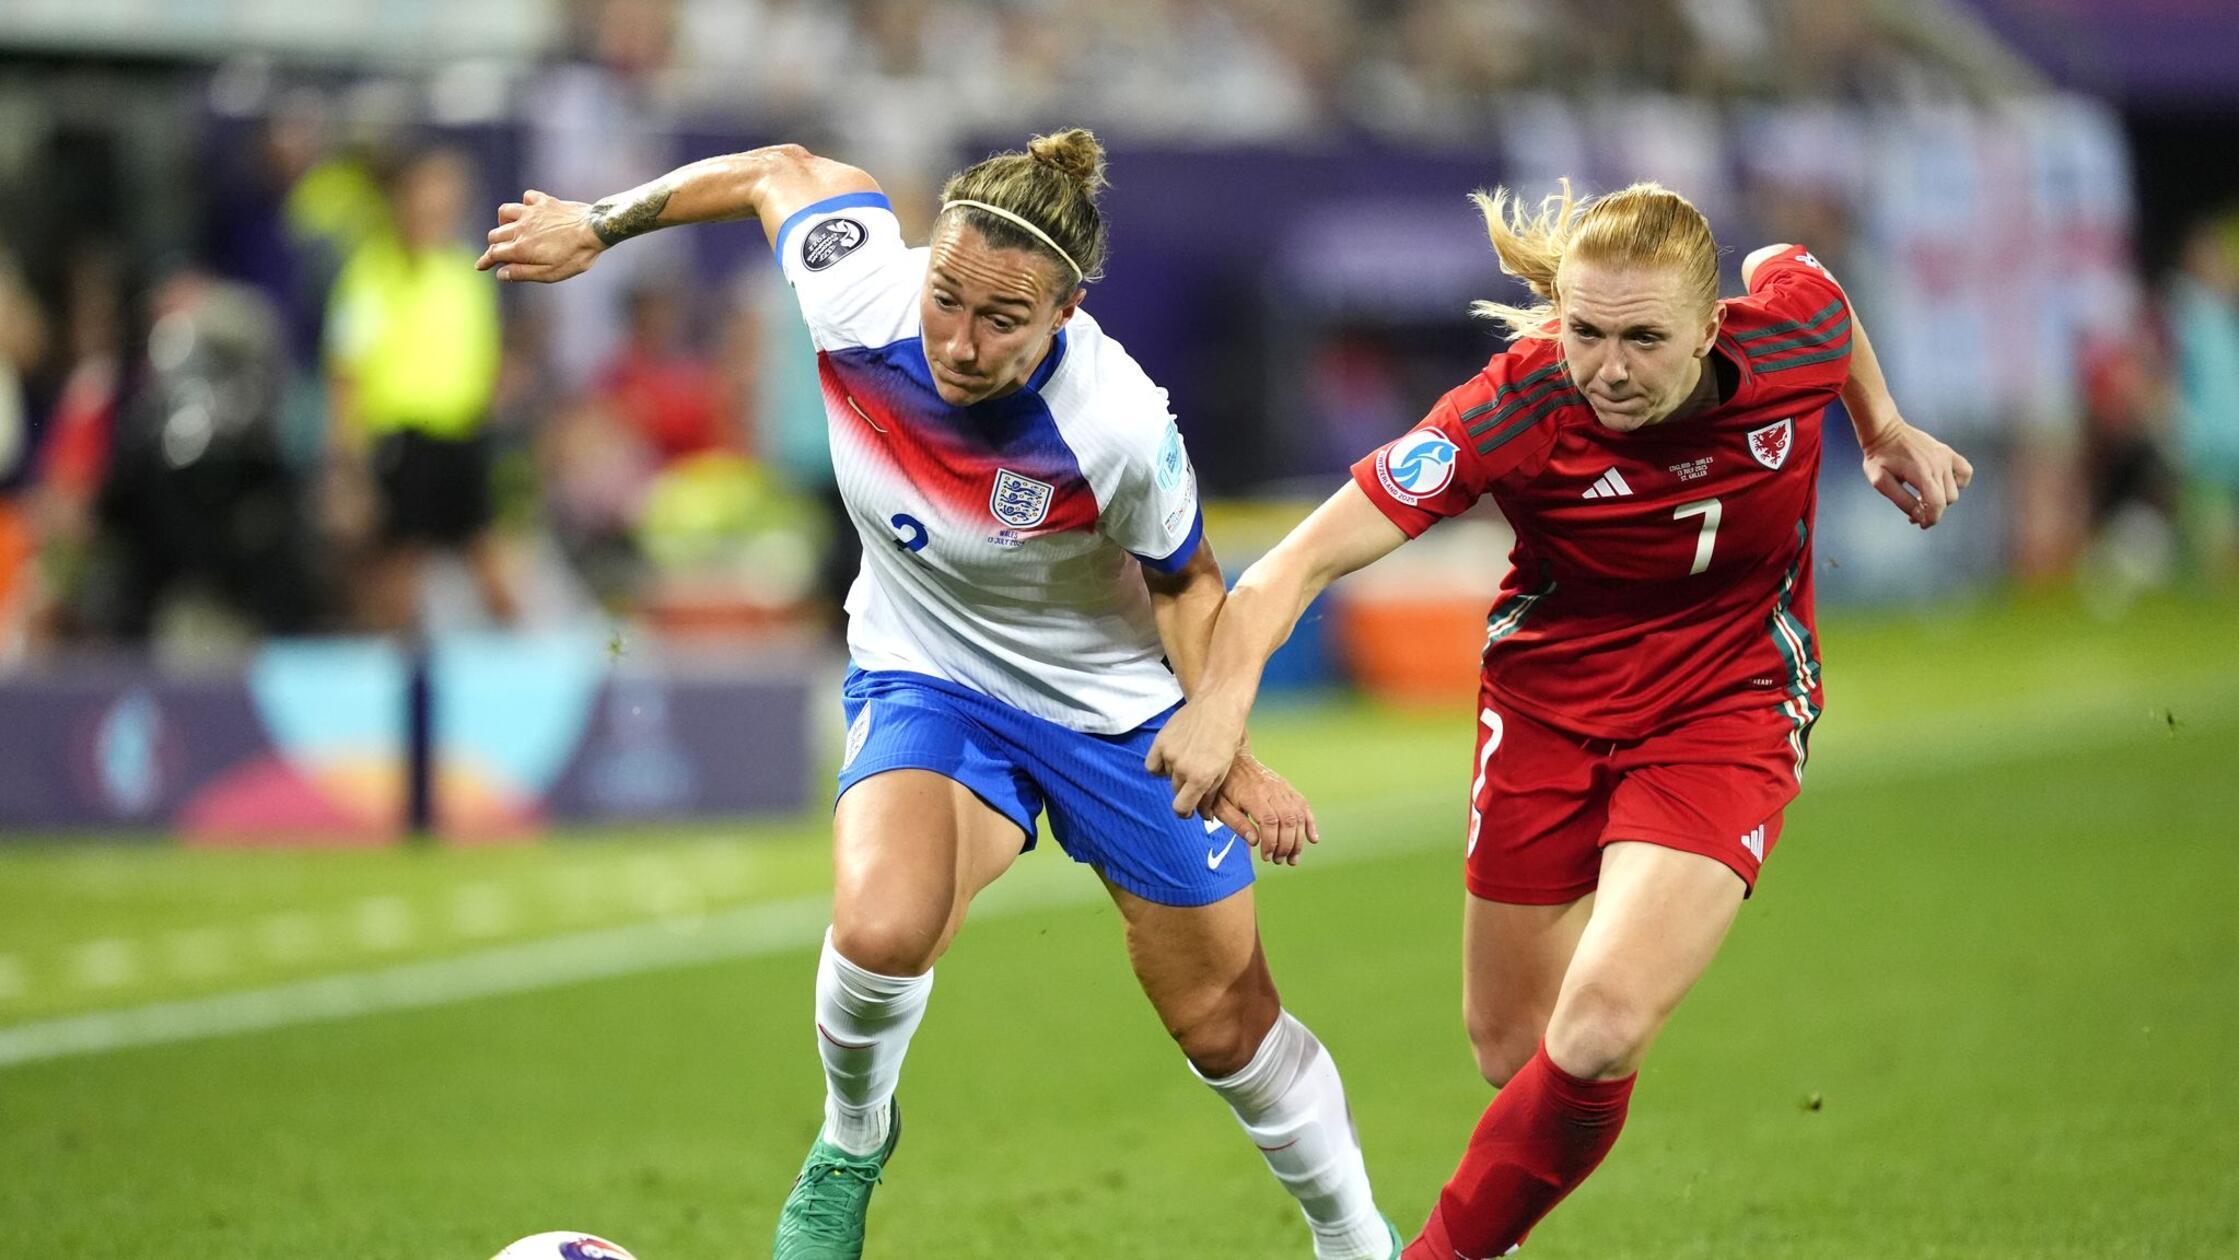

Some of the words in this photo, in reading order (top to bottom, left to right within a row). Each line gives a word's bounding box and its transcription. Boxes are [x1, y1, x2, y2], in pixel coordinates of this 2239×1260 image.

[1694, 464, 1708, 472] 2025
[1398, 489, 1416, 503] 2025
[1673, 498, 1722, 575] 7
[1472, 707, 1504, 804] 7
